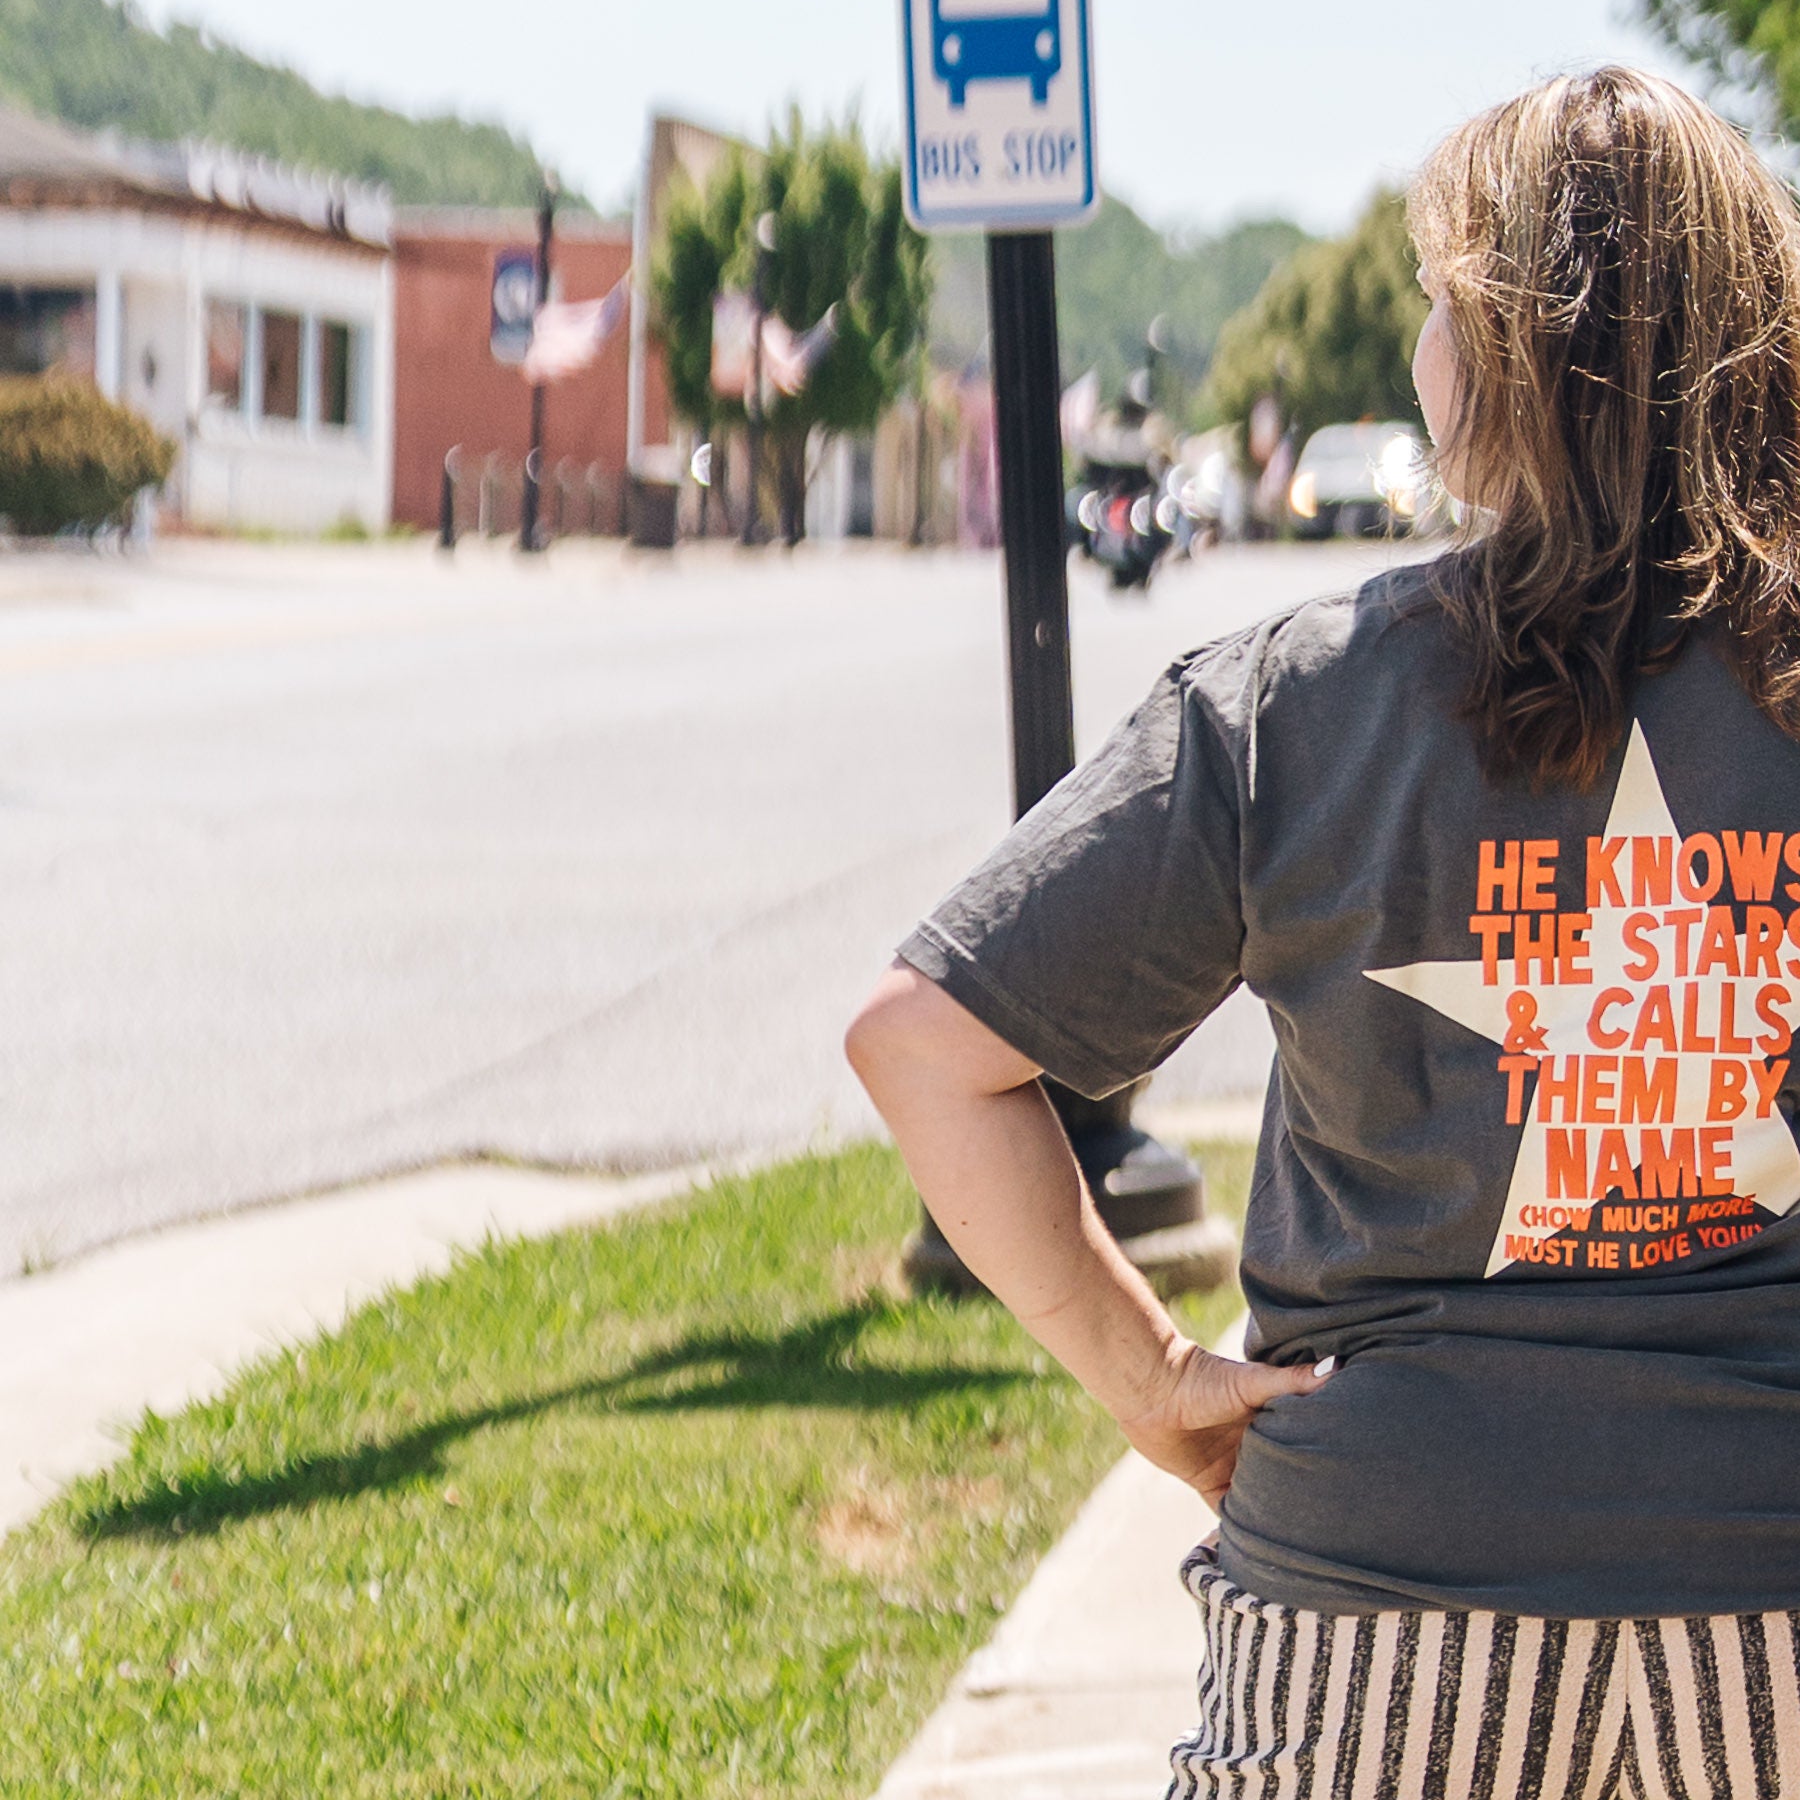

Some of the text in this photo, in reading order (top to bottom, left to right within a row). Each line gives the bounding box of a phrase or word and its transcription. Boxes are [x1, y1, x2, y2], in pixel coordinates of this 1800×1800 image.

[921, 130, 1077, 182] BUS STOP
[1476, 839, 1560, 911] HE
[1469, 913, 1593, 986] THE
[1502, 982, 1793, 1055] & CALLS
[1497, 1054, 1791, 1125] THEM BY
[1545, 1126, 1735, 1200] NAME
[1519, 1193, 1757, 1233] (HOW MUCH MORE
[1504, 1234, 1578, 1267] MUST
[1587, 1241, 1620, 1269] HE
[1629, 1232, 1692, 1269] LOVE
